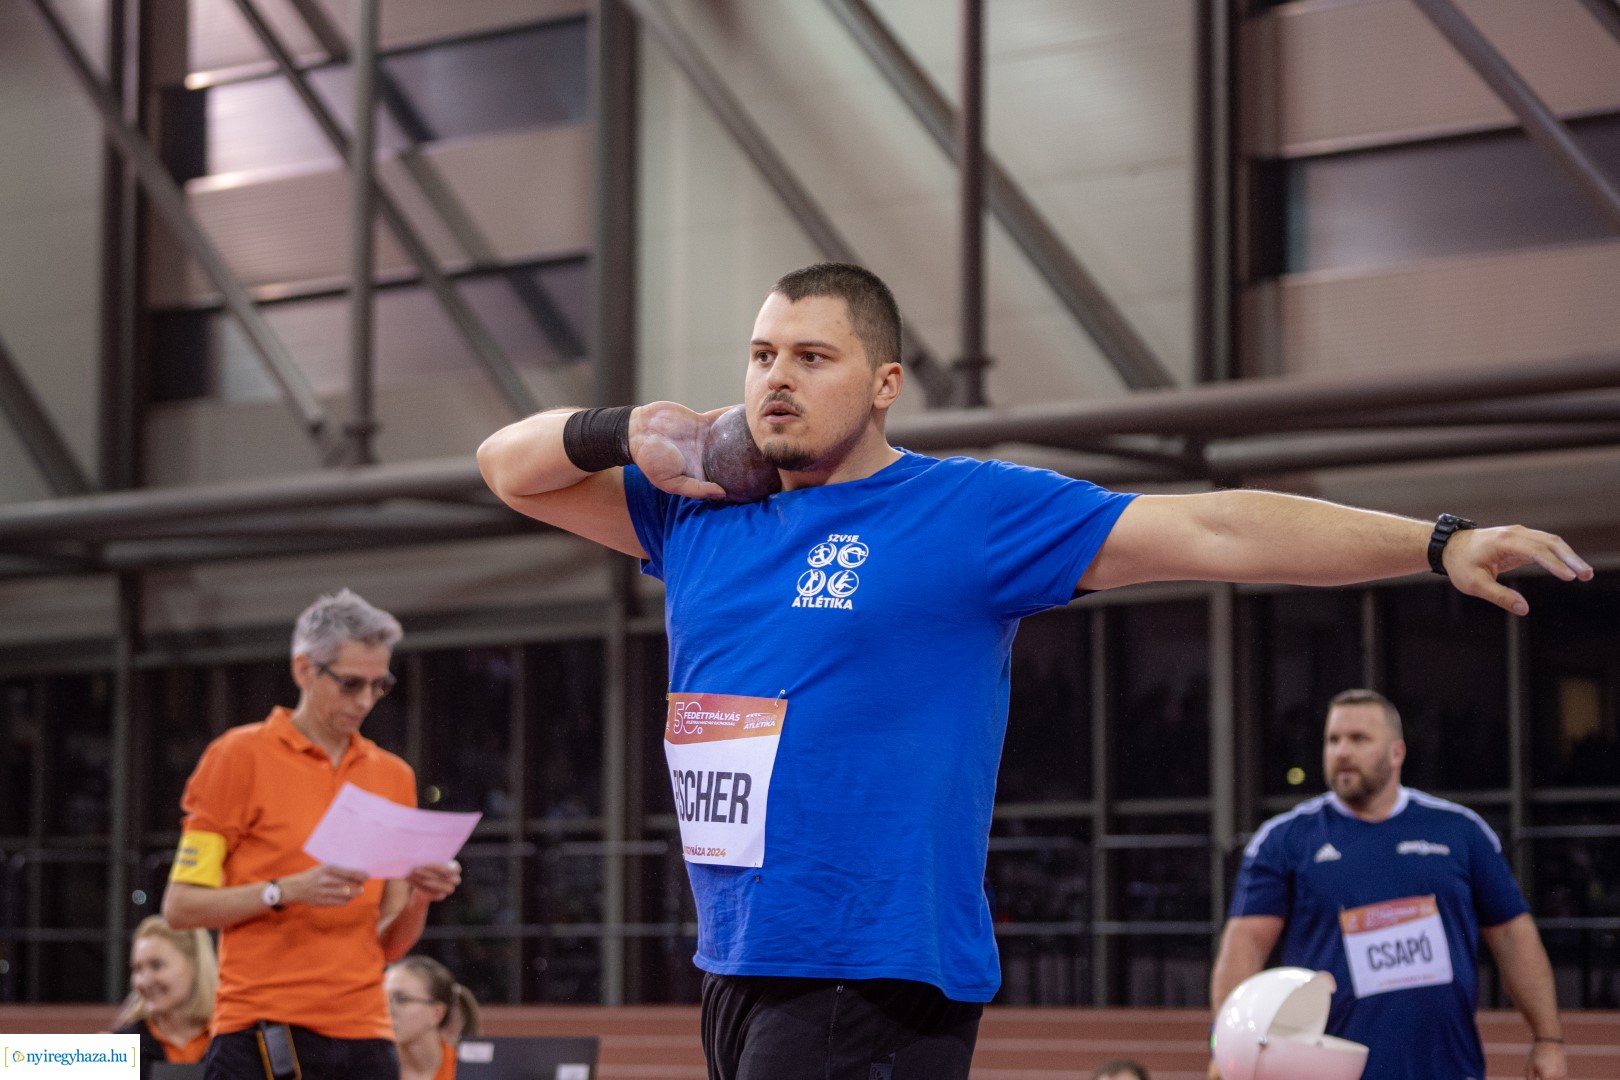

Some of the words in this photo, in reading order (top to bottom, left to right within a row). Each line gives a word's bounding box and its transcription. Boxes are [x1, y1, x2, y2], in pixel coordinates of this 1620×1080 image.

[791, 595, 853, 610] ATLÉTIKA
[683, 711, 740, 721] FEDETTPÁLYÁS
[706, 848, 727, 857] 2024
[1367, 931, 1433, 972] CSAPÓ
